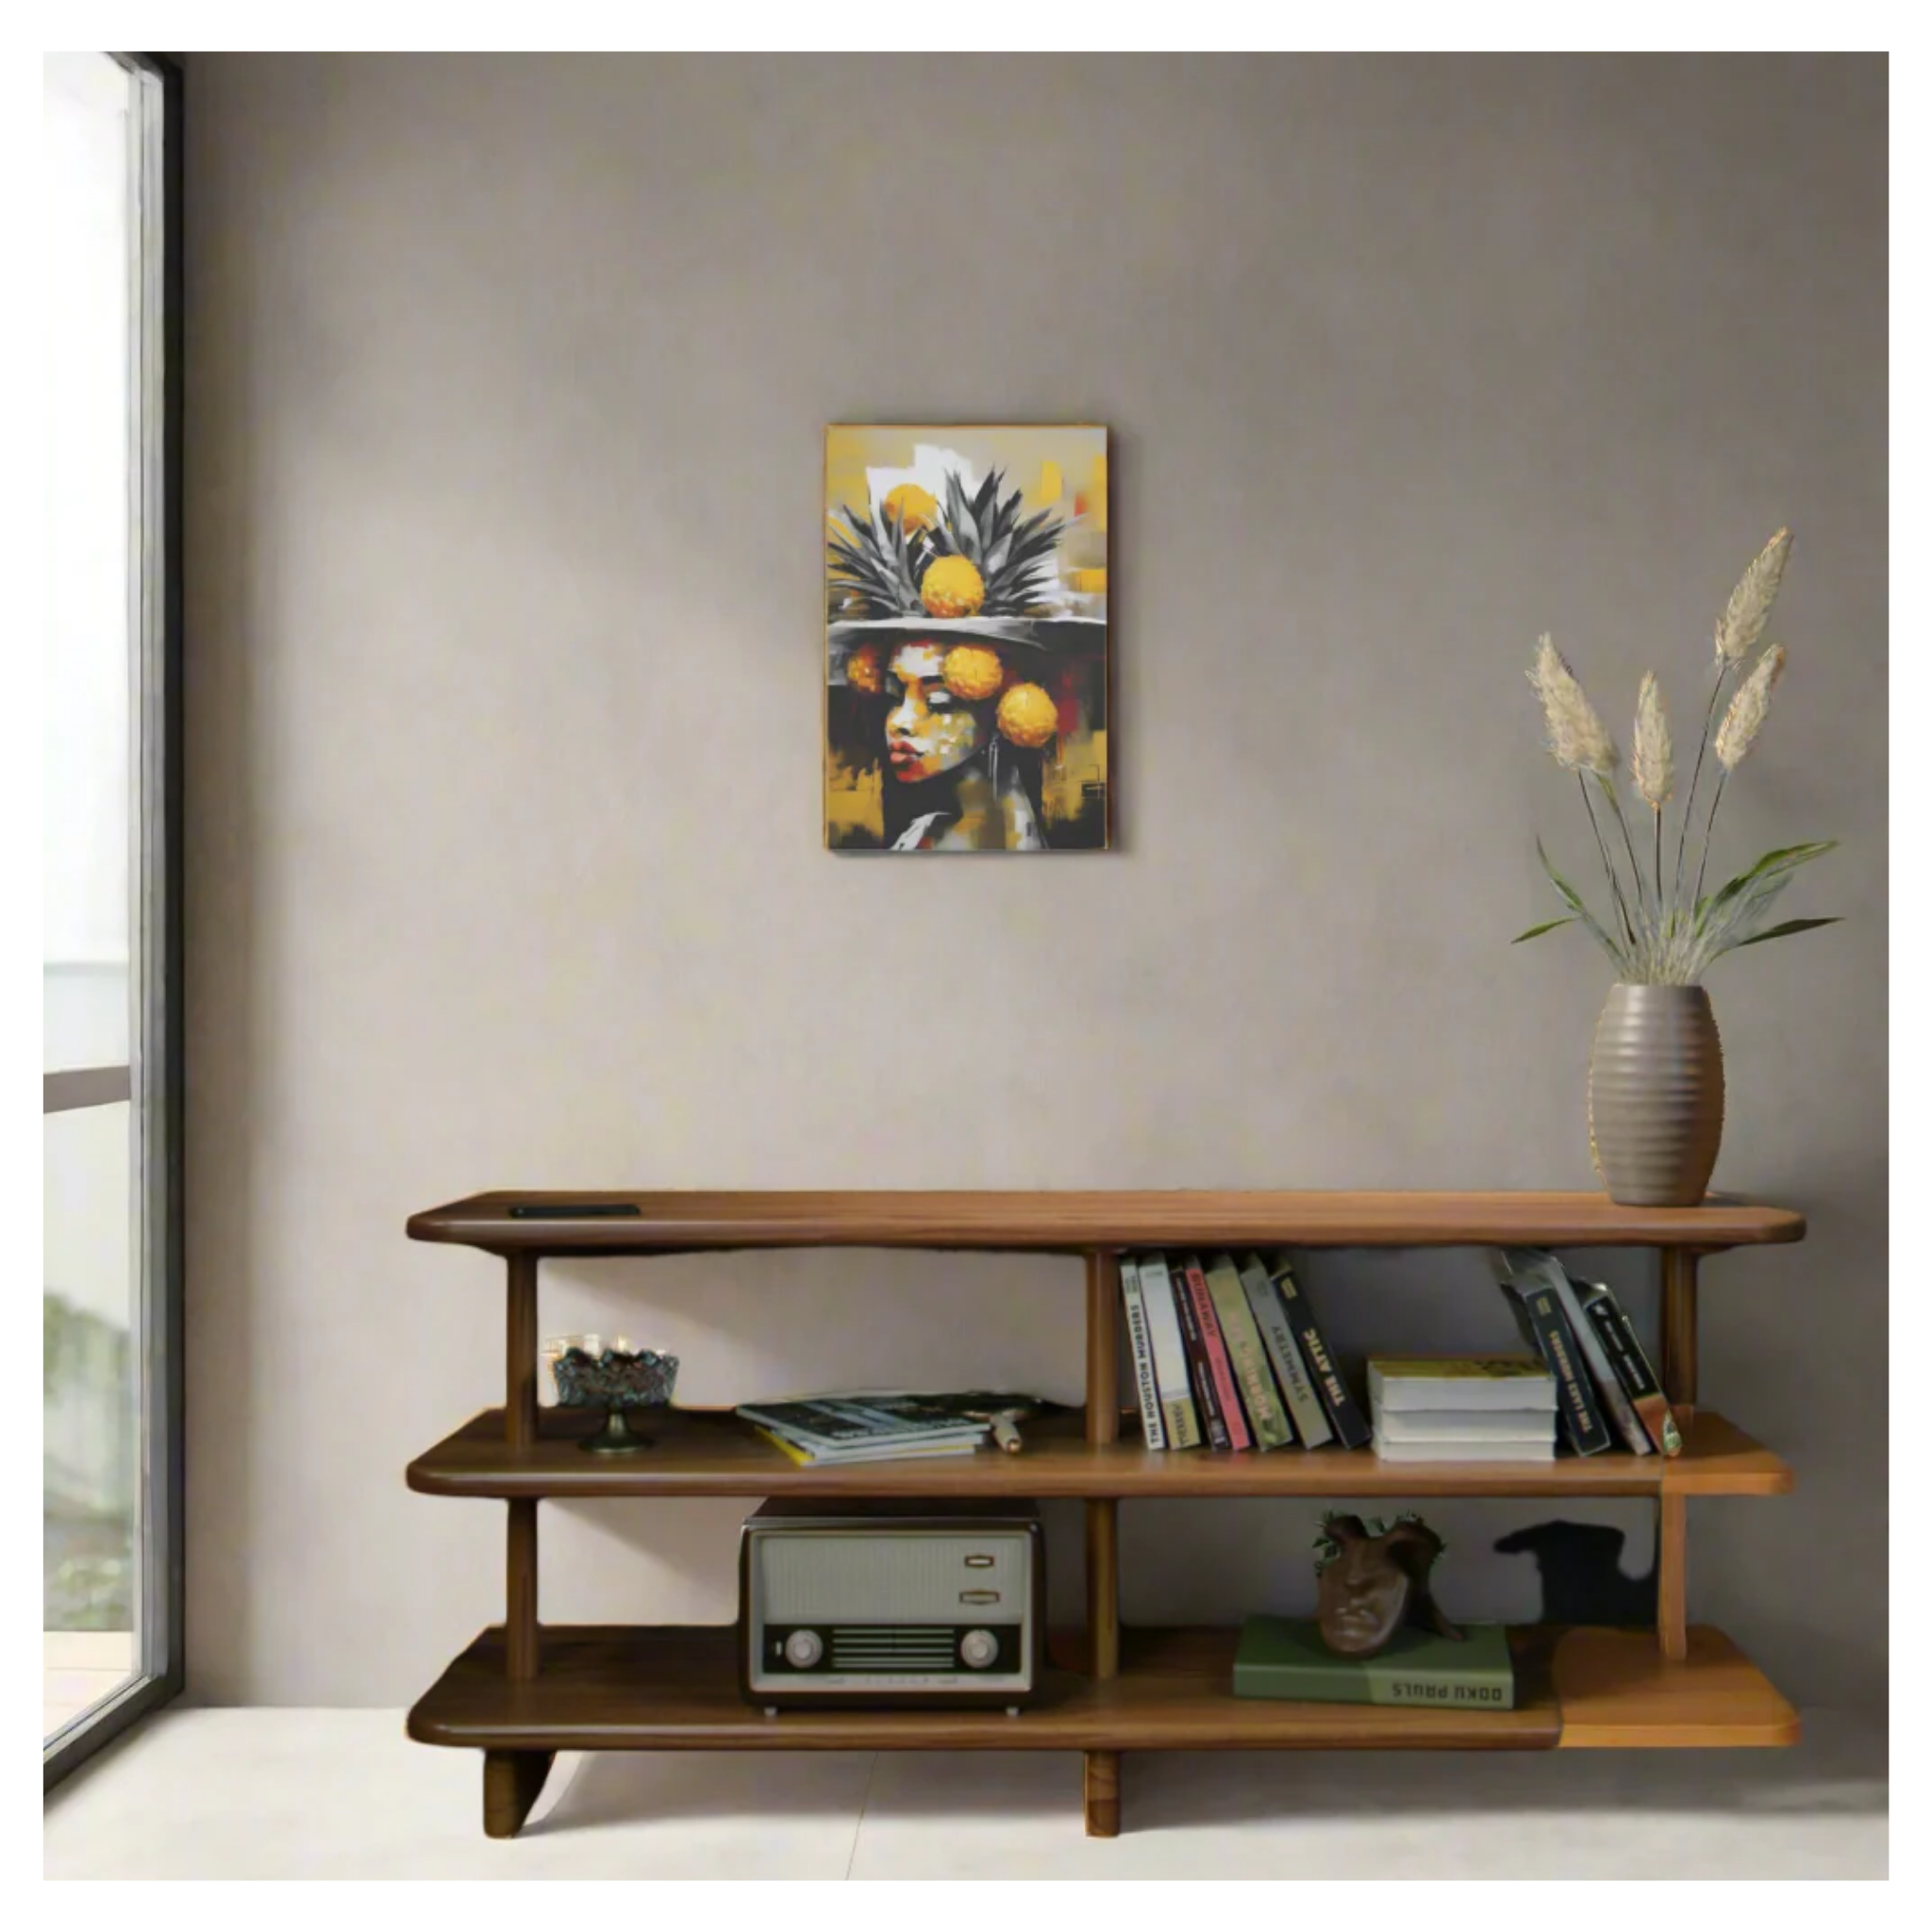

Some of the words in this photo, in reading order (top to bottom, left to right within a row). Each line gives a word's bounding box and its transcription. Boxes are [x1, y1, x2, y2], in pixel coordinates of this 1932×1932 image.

[1130, 1304, 1146, 1359] MURDERS
[1303, 1327, 1332, 1373] ATTIC
[1270, 1326, 1309, 1402] SYMMETRY
[1139, 1362, 1156, 1419] HOUSTON
[1324, 1374, 1345, 1407] THE
[1148, 1422, 1160, 1444] THE
[1392, 1683, 1448, 1699] PAULS
